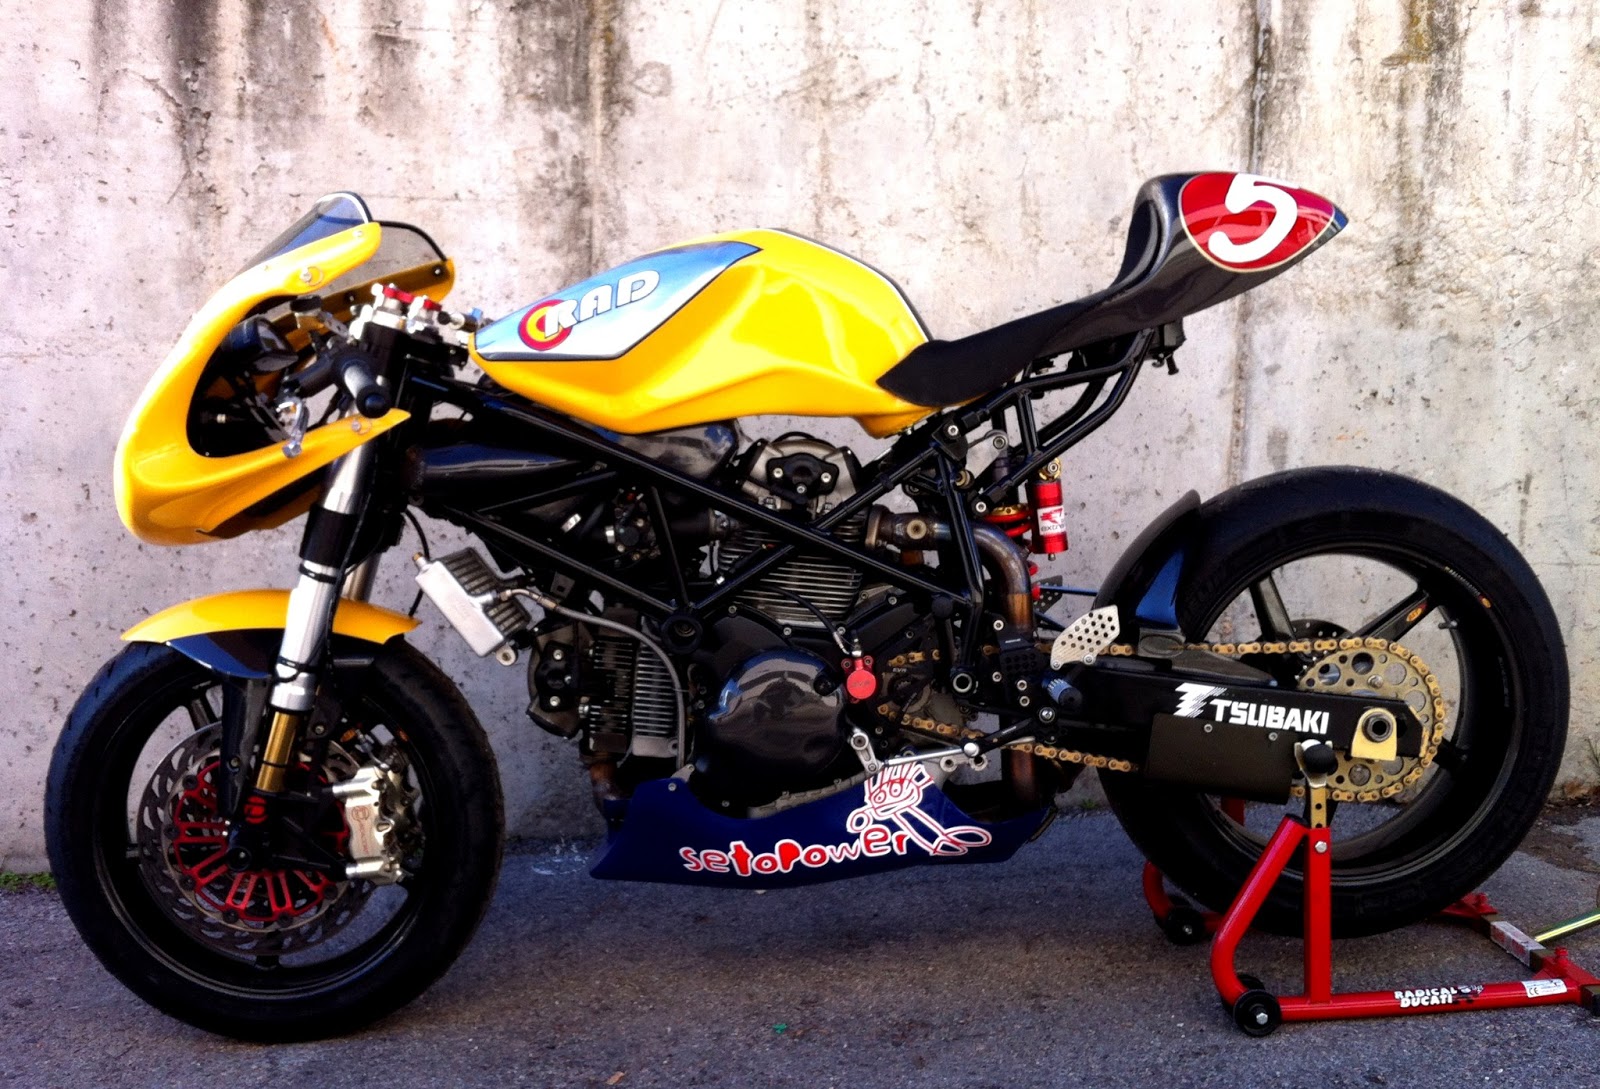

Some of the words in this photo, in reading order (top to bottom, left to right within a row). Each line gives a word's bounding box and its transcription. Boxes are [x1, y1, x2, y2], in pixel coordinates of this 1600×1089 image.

[1207, 173, 1299, 263] 5
[1209, 698, 1330, 735] TSUBAKI
[1394, 986, 1458, 1000] RADICAL
[1400, 994, 1453, 1009] DUCATI
